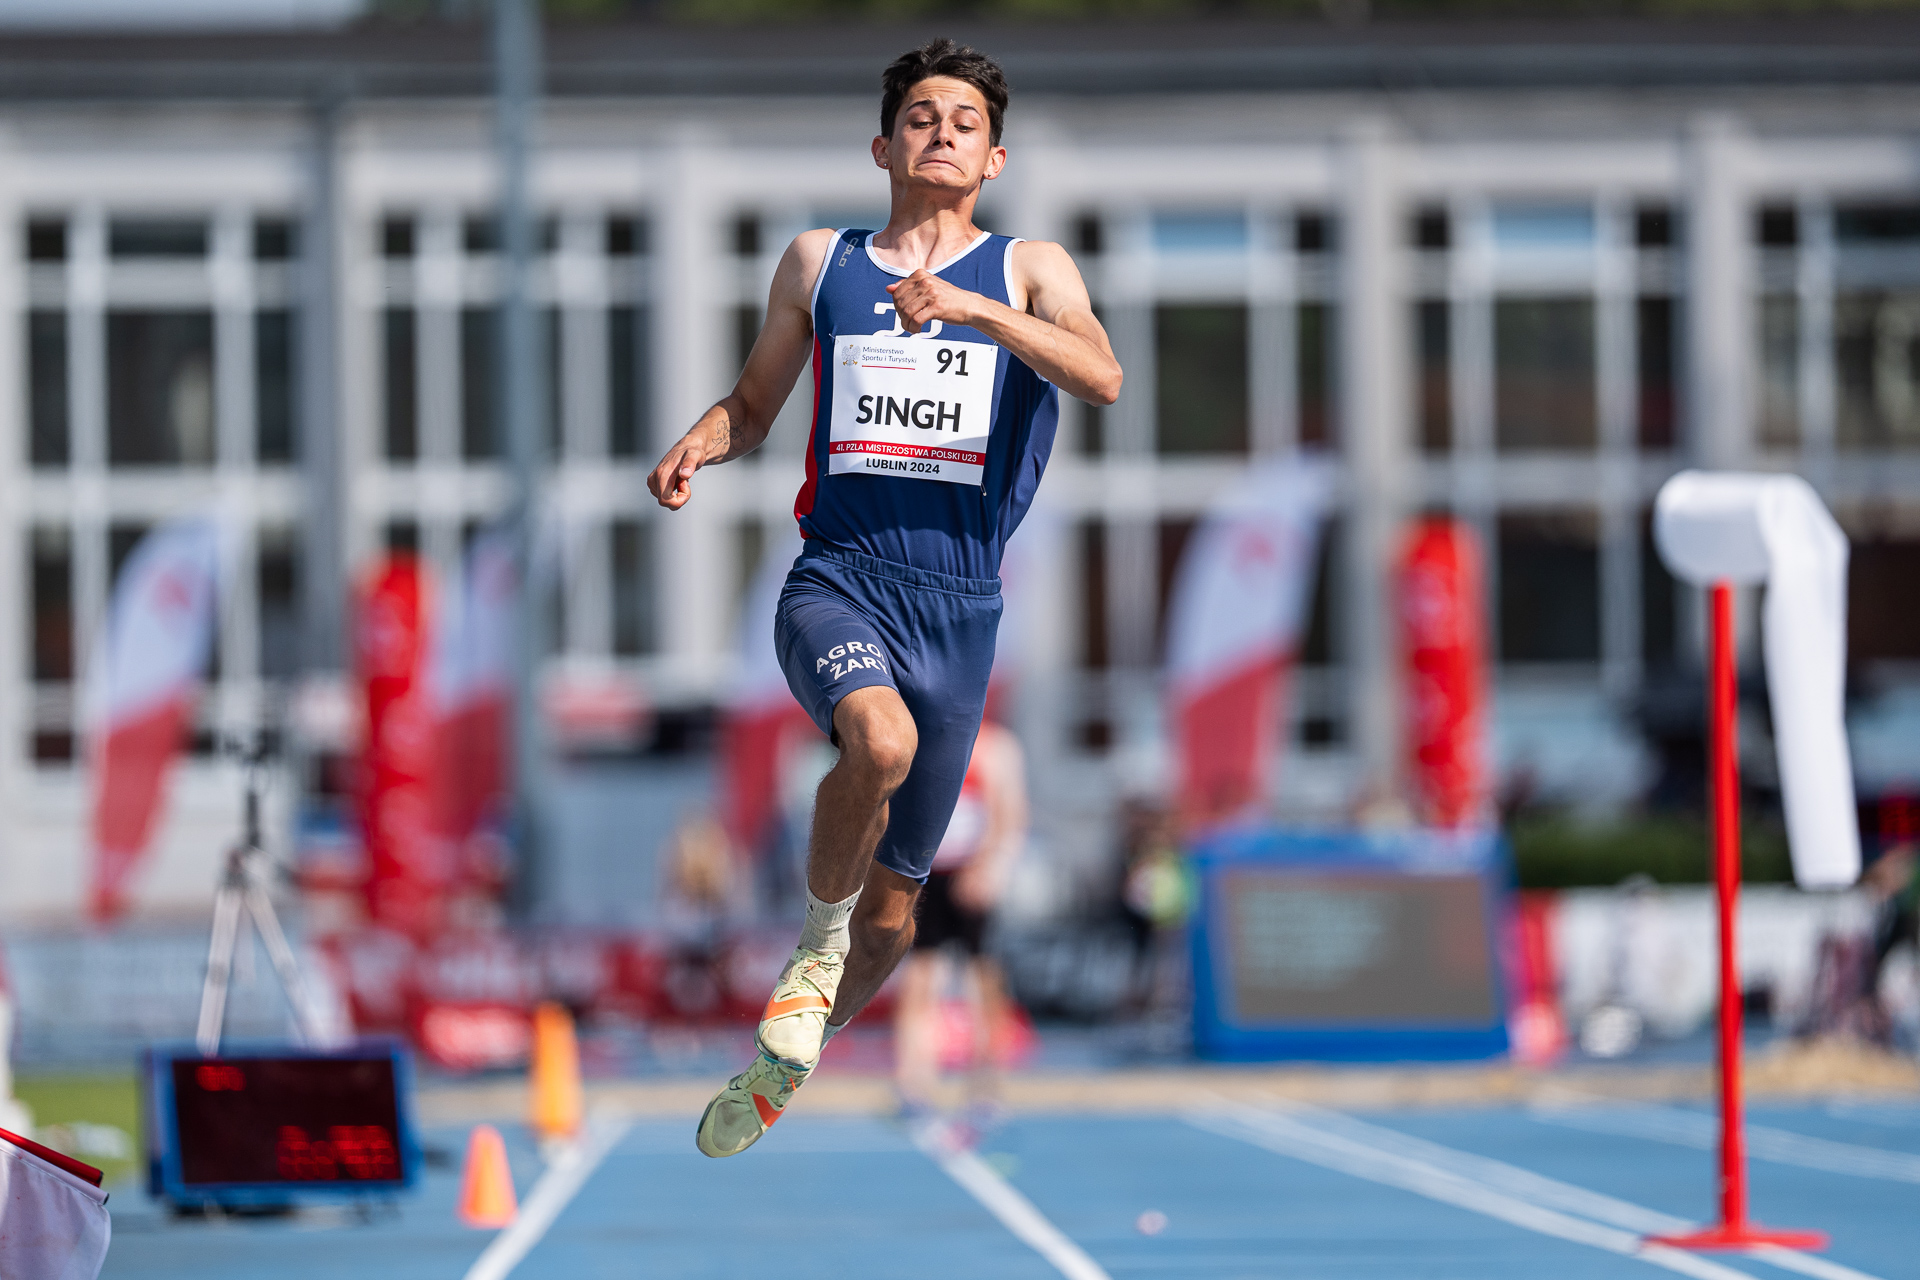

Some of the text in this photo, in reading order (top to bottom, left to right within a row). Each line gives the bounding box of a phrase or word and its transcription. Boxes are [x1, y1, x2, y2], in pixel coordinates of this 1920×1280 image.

[838, 237, 859, 267] COLO
[862, 346, 904, 355] Ministerstwo
[862, 354, 883, 362] Sportu
[888, 356, 917, 364] Turystyki
[936, 348, 969, 376] 91
[855, 394, 962, 433] SINGH
[836, 443, 977, 463] 41. PZLA MISTRZOSTWA POLSKI U23
[865, 458, 940, 475] LUBLIN 2024
[816, 641, 885, 674] AGRO
